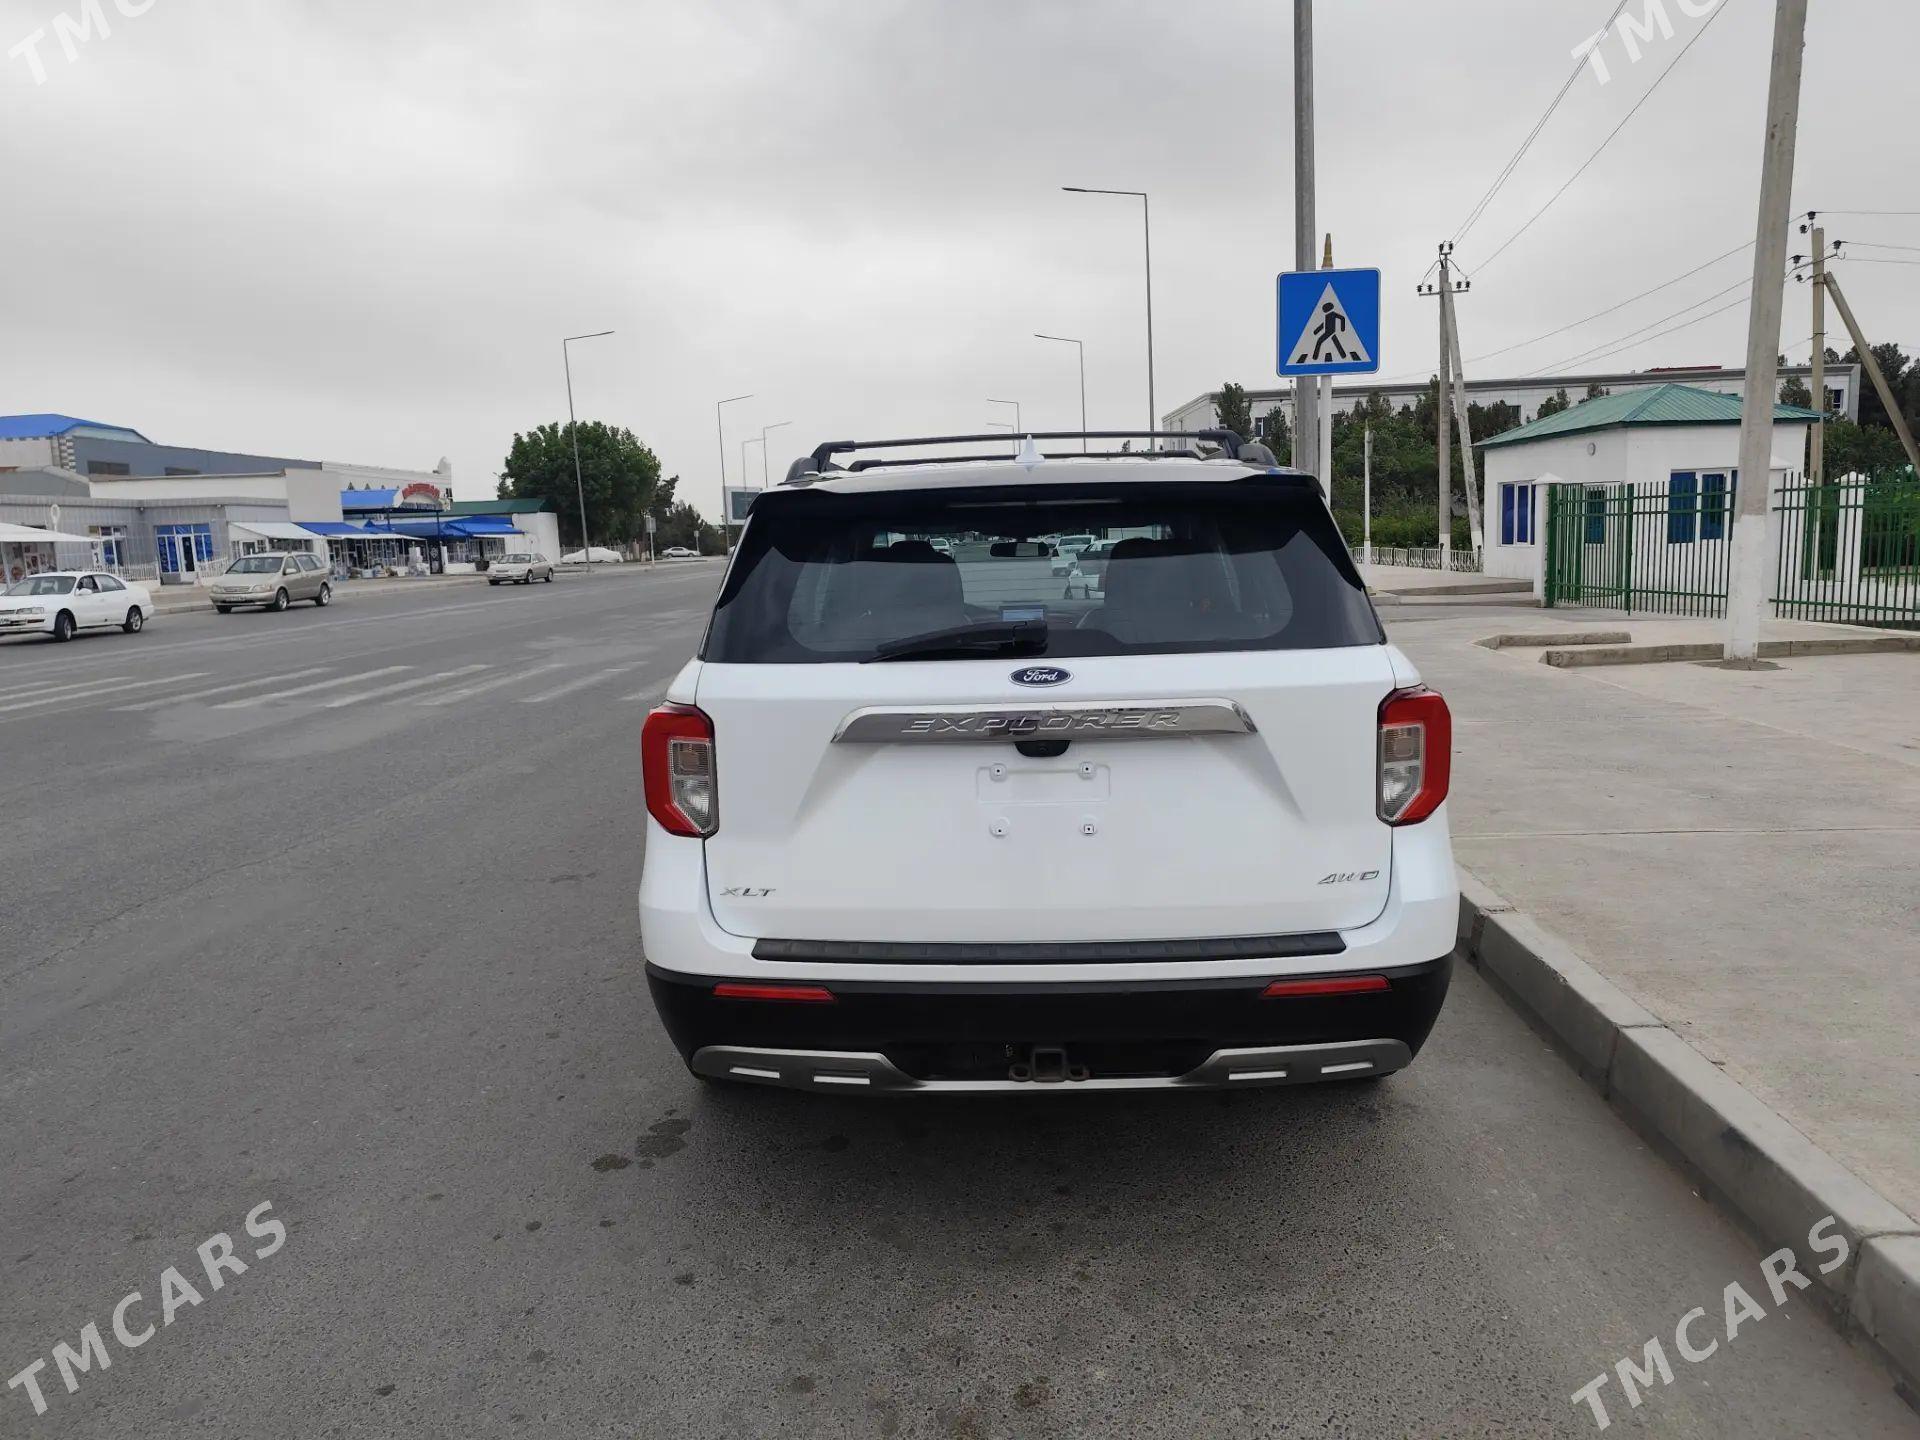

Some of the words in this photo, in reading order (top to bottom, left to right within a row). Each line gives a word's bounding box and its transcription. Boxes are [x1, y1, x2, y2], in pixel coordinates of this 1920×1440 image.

[1023, 668, 1059, 682] Ford
[901, 710, 1182, 733] EXPLORER
[1318, 869, 1380, 885] 4WD
[719, 886, 777, 898] XLT
